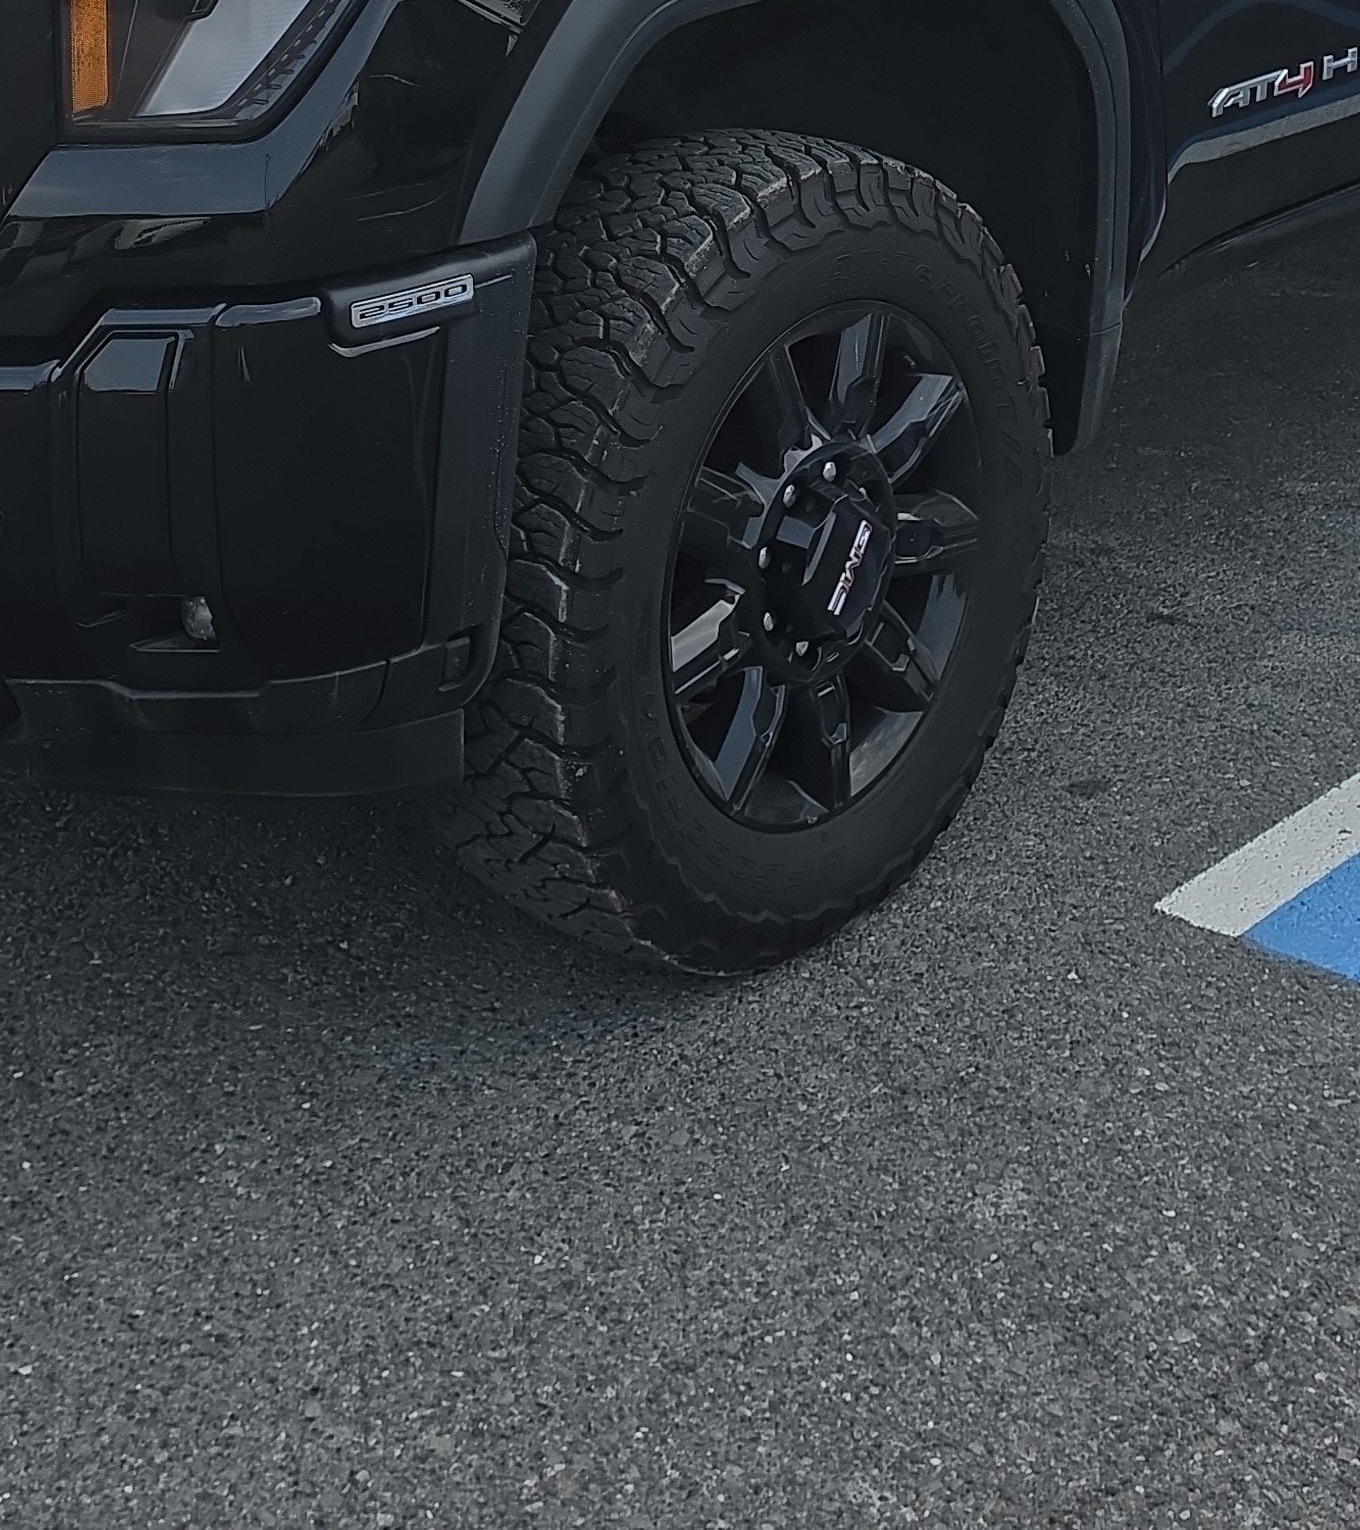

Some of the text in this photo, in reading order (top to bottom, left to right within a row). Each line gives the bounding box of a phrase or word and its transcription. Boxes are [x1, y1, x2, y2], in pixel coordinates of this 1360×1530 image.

[1207, 60, 1314, 117] AT4
[358, 283, 469, 320] 2500
[827, 519, 873, 616] GMC
